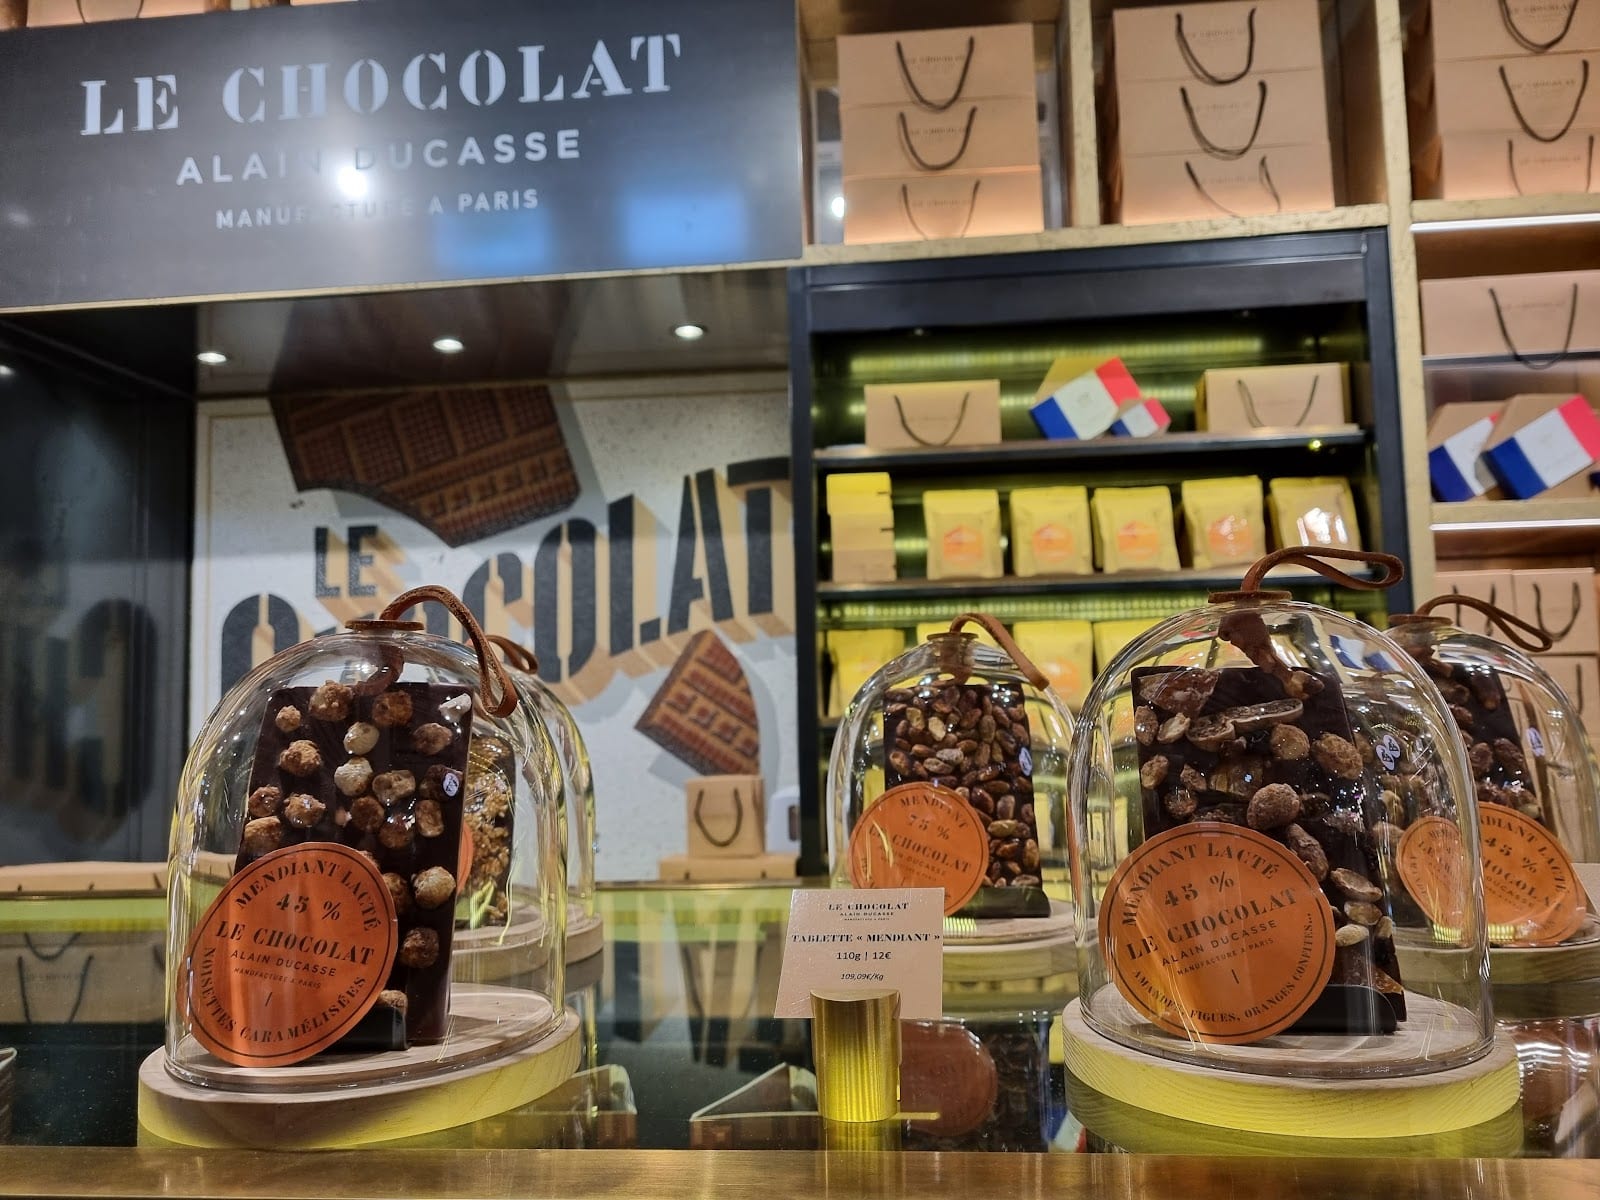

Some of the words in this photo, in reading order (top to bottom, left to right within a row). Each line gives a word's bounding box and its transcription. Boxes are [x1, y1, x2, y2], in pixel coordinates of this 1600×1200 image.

[81, 74, 180, 136] LE
[222, 33, 680, 124] CHOCOLAT
[177, 150, 324, 186] ALAIN
[353, 128, 581, 170] DUCASSE
[458, 188, 539, 213] PARIS
[314, 523, 378, 598] LE
[892, 834, 971, 873] CHOCOLAT
[235, 859, 341, 909] MENDIANT
[341, 869, 382, 931] LACTÉ
[1121, 843, 1198, 927] MENDIANT
[1207, 842, 1281, 881] LACTÉ
[1164, 883, 1199, 907] 45
[1209, 871, 1235, 893] %
[276, 893, 310, 914] 45
[321, 901, 341, 921] %
[828, 903, 842, 911] LE
[847, 902, 909, 910] CHOCOLAT
[1126, 935, 1159, 960] LE
[1166, 888, 1298, 944] CHOCOLAT
[215, 920, 246, 941] LE
[253, 927, 375, 965] CHOCOLAT
[791, 933, 853, 943] TABLETTE
[866, 933, 931, 942] MENDIANT
[836, 951, 861, 961] 110g
[872, 951, 891, 960] 12€
[1162, 944, 1205, 967] ALAIN
[1211, 919, 1278, 949] DUCASSE
[1248, 937, 1275, 951] PARIS
[230, 949, 272, 964] ALAIN
[275, 957, 337, 977] DUCASSE
[840, 972, 884, 981] 109,09€/Kg
[200, 946, 238, 1033] NOISETTES
[240, 976, 366, 1043] CARAMÉLISÉES
[1244, 982, 1296, 1019] ORANGES
